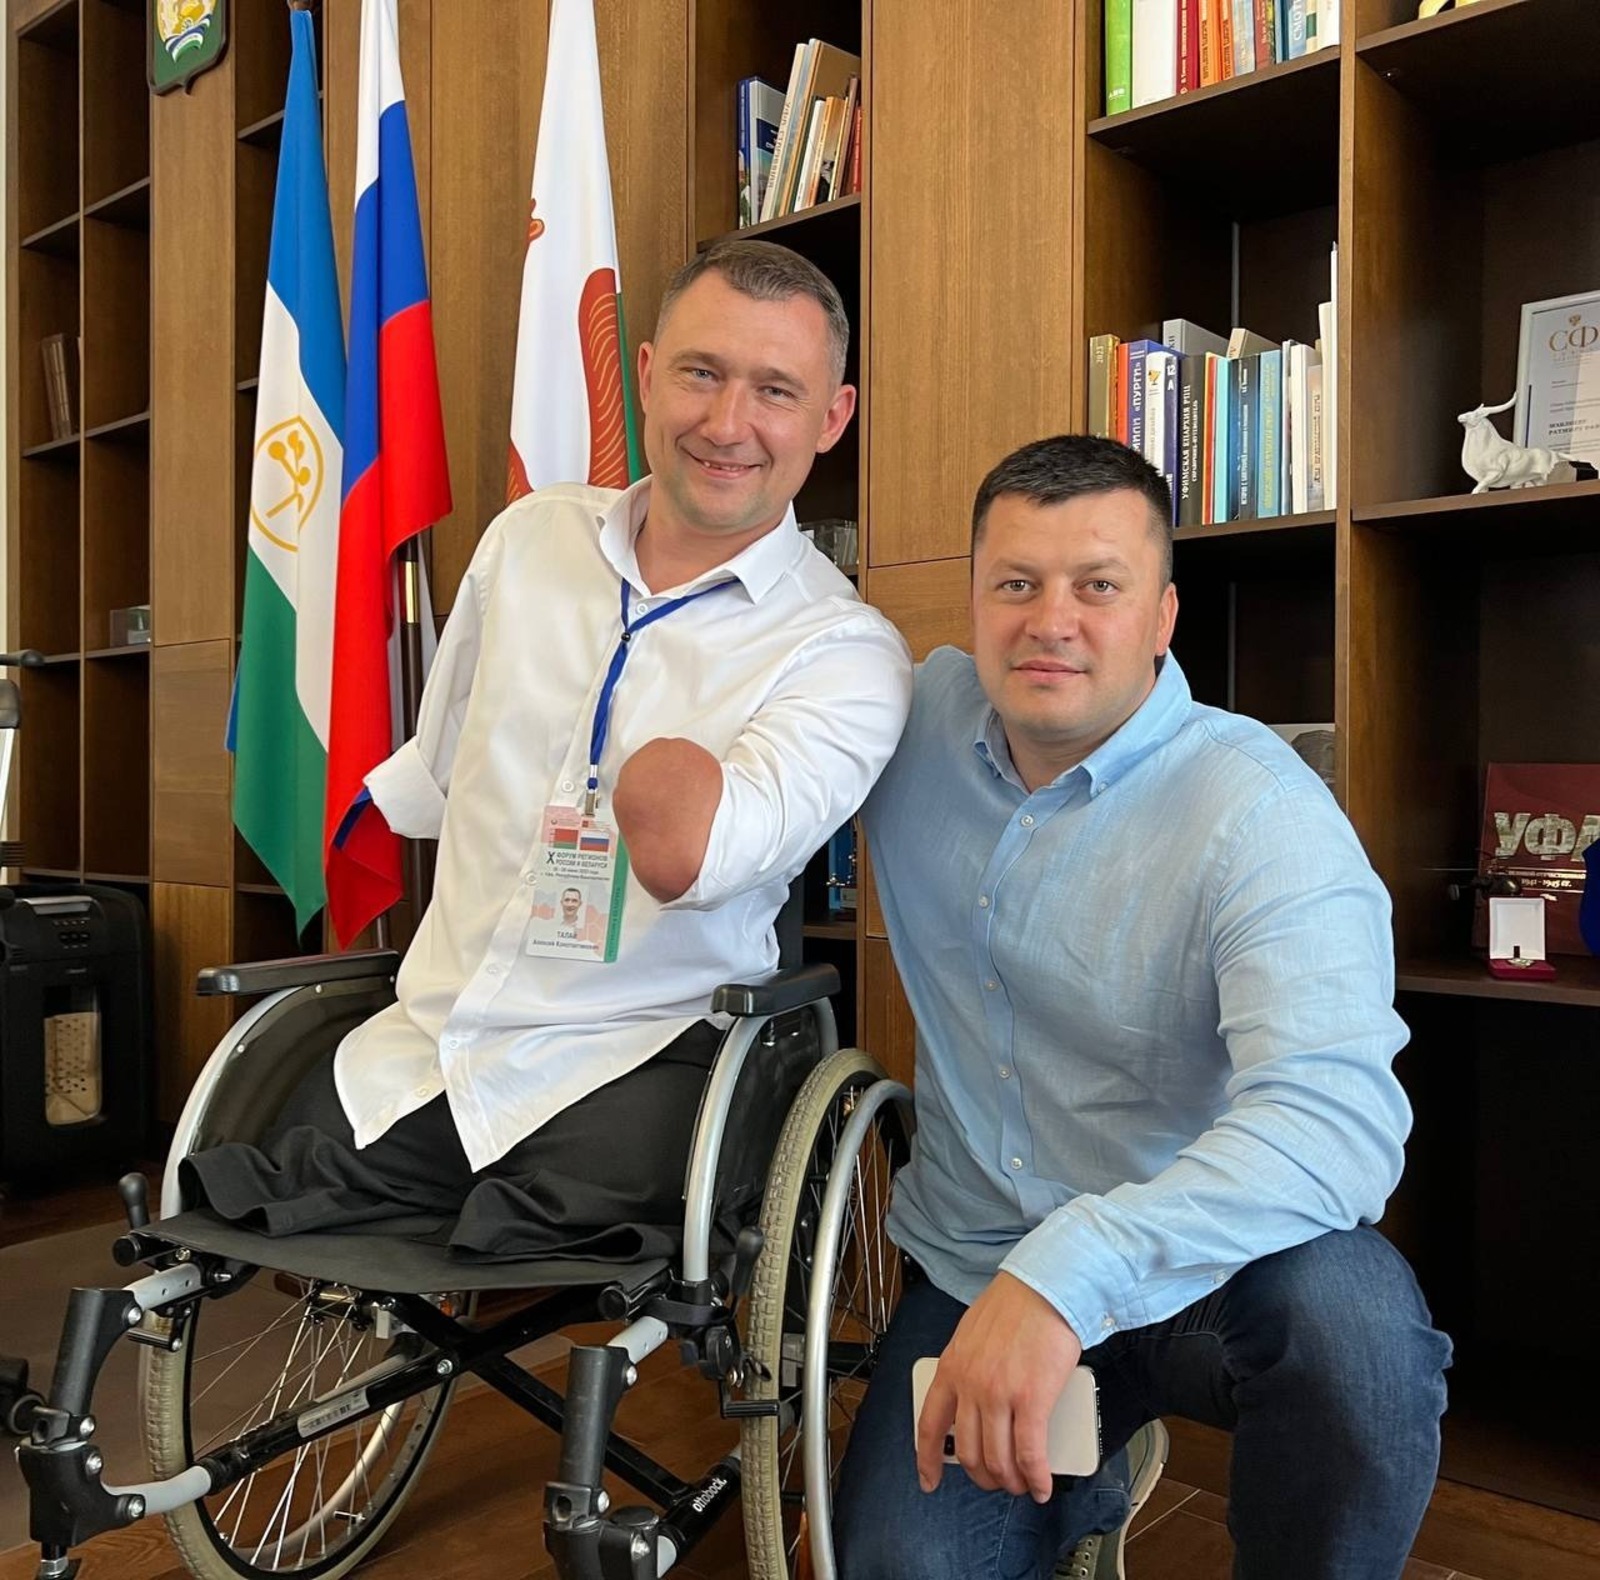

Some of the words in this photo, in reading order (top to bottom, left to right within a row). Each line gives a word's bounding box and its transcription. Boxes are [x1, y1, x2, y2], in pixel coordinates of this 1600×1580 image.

[1293, 0, 1303, 40] СМОТ
[1182, 407, 1191, 447] ЕПАРХИЯ
[1182, 449, 1190, 499] УФИМСКАЯ
